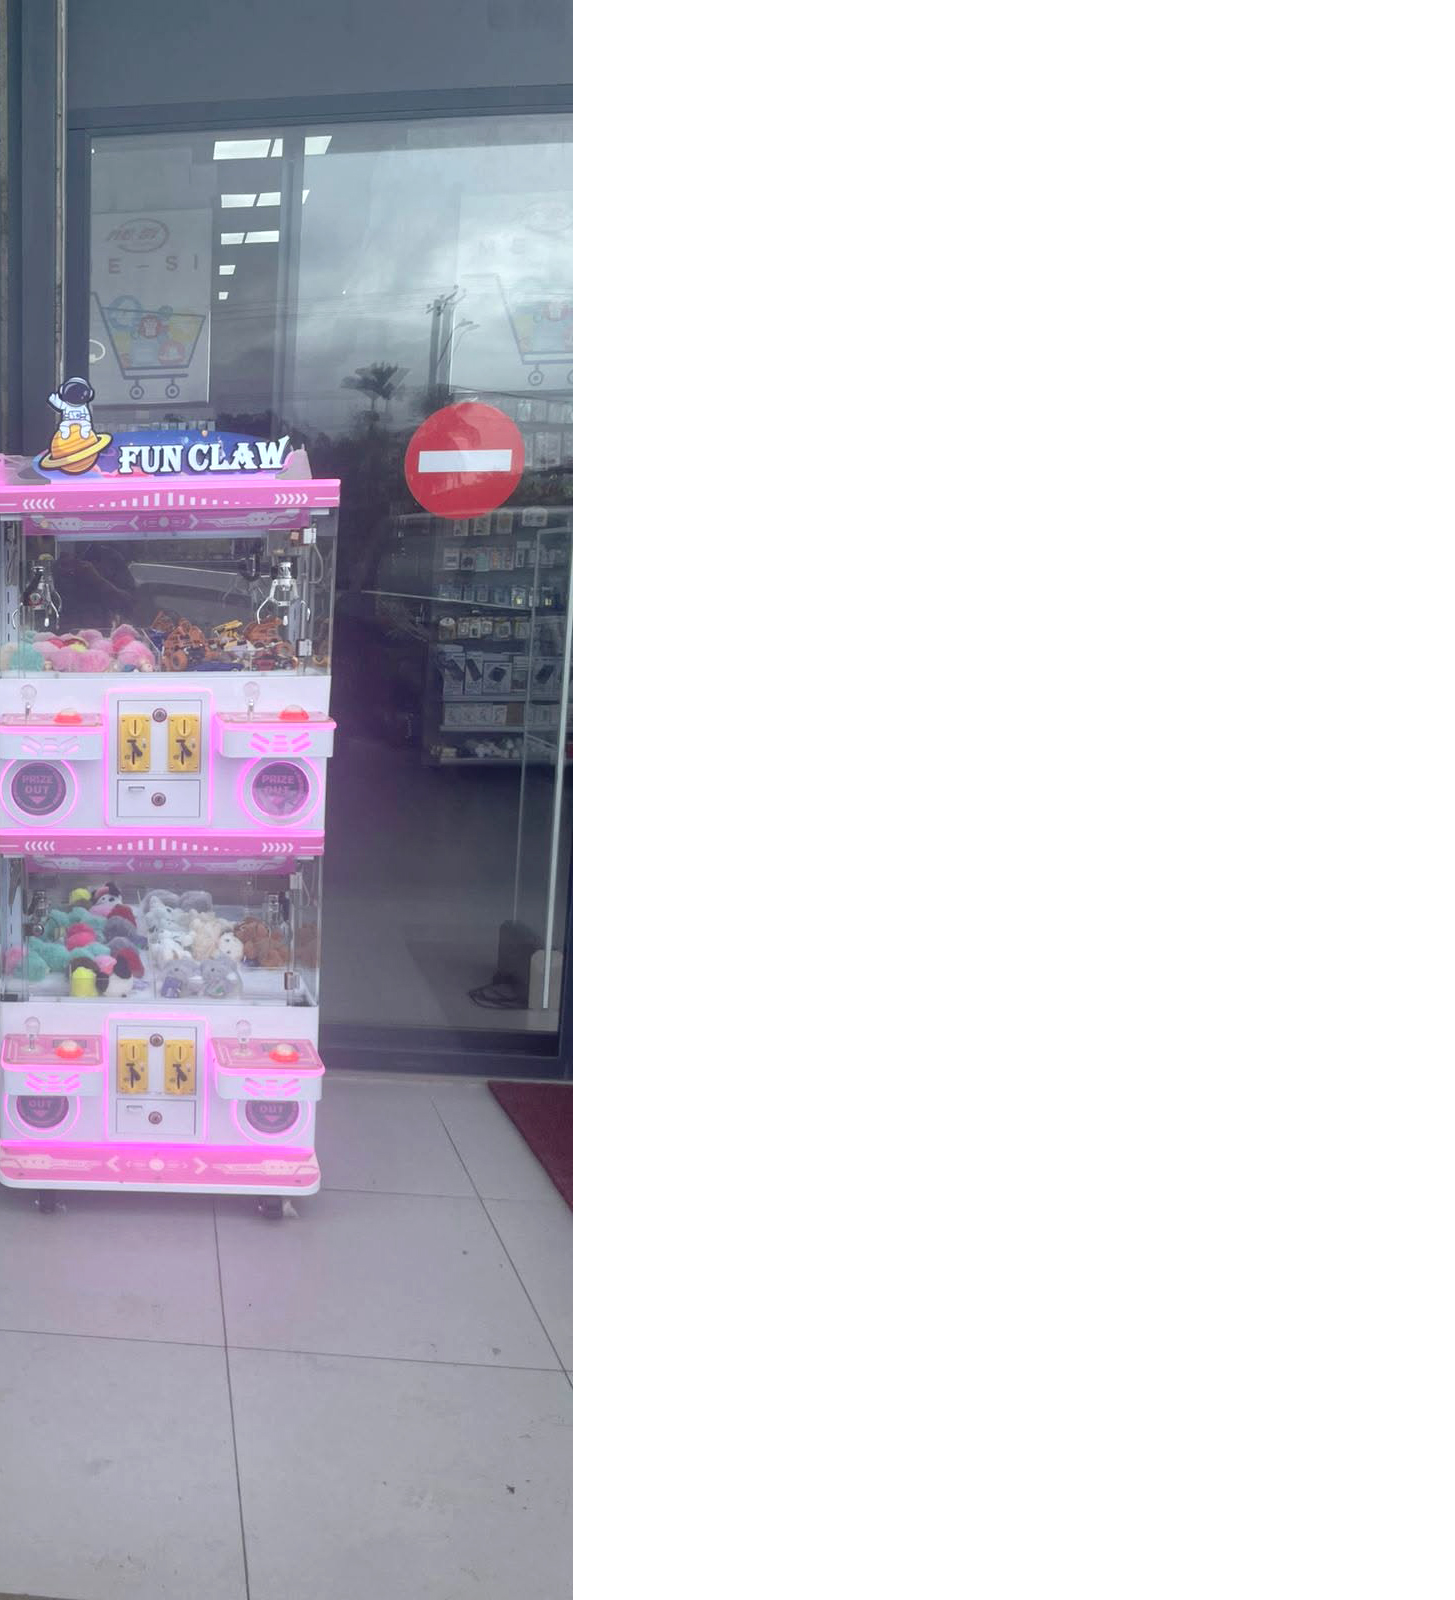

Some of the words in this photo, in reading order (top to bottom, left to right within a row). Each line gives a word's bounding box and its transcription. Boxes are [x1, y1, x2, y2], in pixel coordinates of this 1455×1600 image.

[118, 445, 183, 474] FUN
[188, 436, 289, 472] CLAW
[22, 775, 54, 784] PRIZE
[25, 785, 50, 794] OUT
